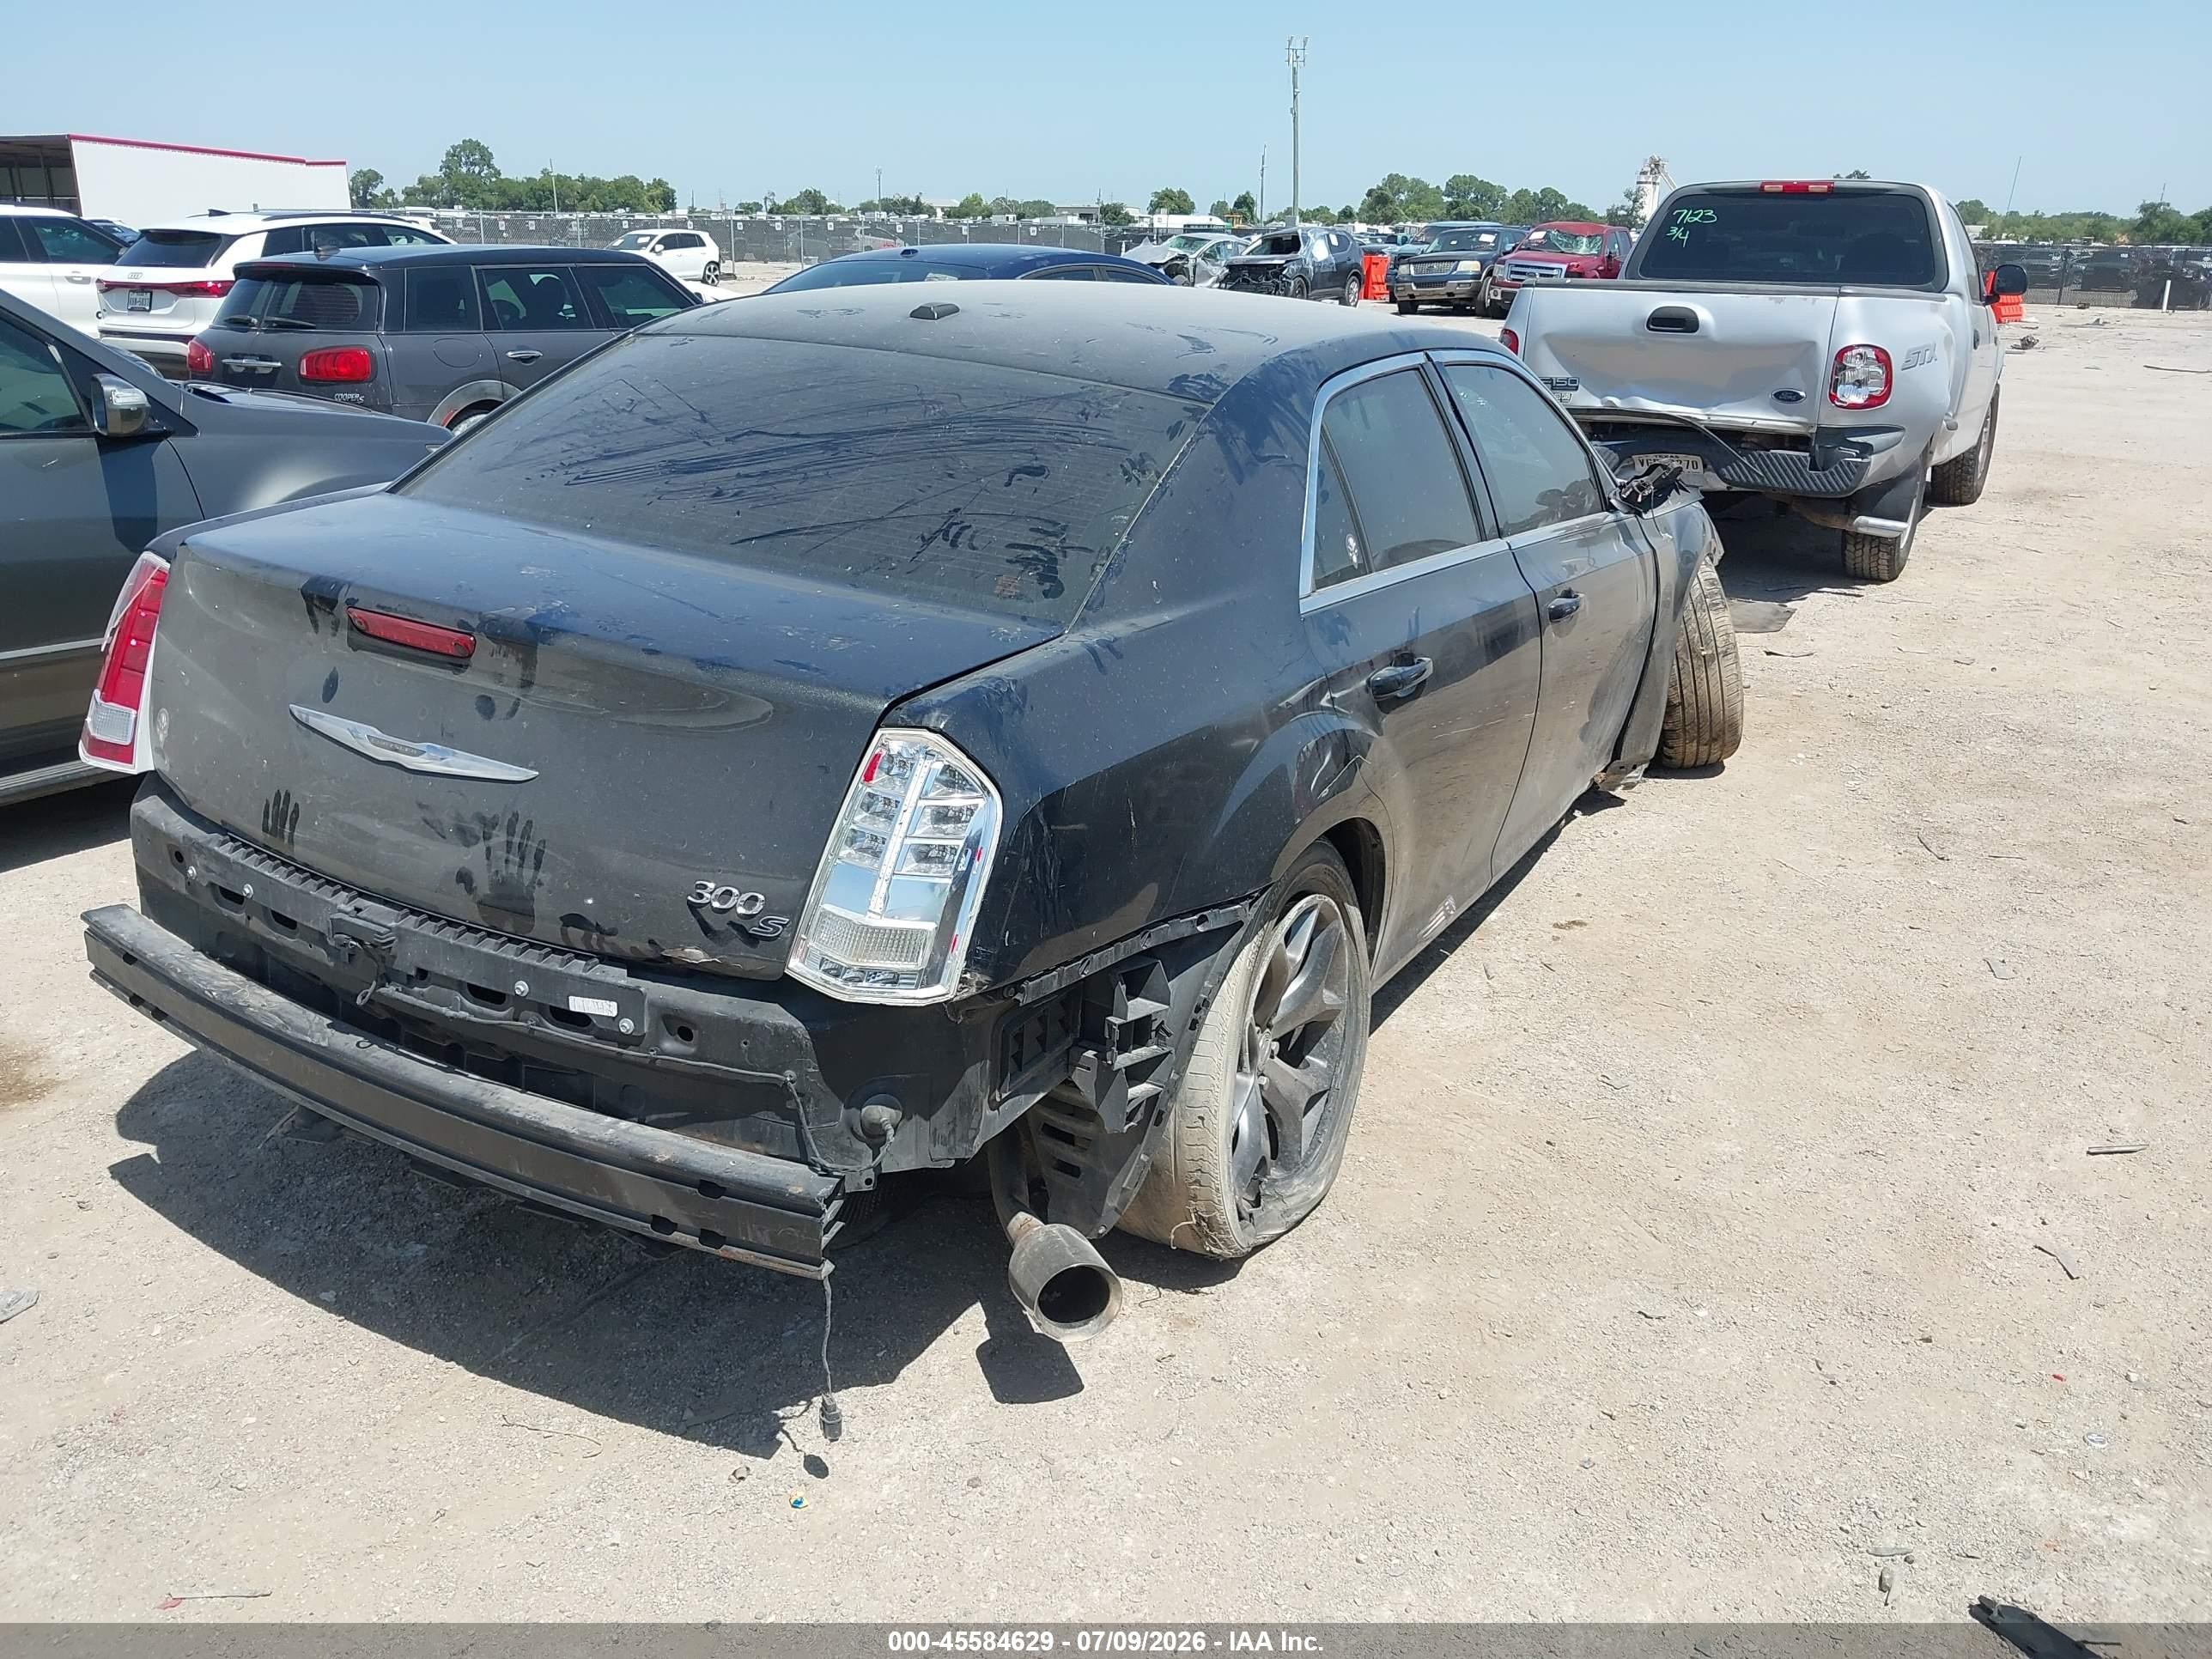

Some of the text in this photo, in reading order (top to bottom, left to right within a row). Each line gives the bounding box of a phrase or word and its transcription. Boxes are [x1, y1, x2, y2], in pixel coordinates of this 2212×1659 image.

[1666, 226, 1690, 248] 3/4
[1900, 343, 1937, 371] STX
[686, 880, 790, 938] 300 S
